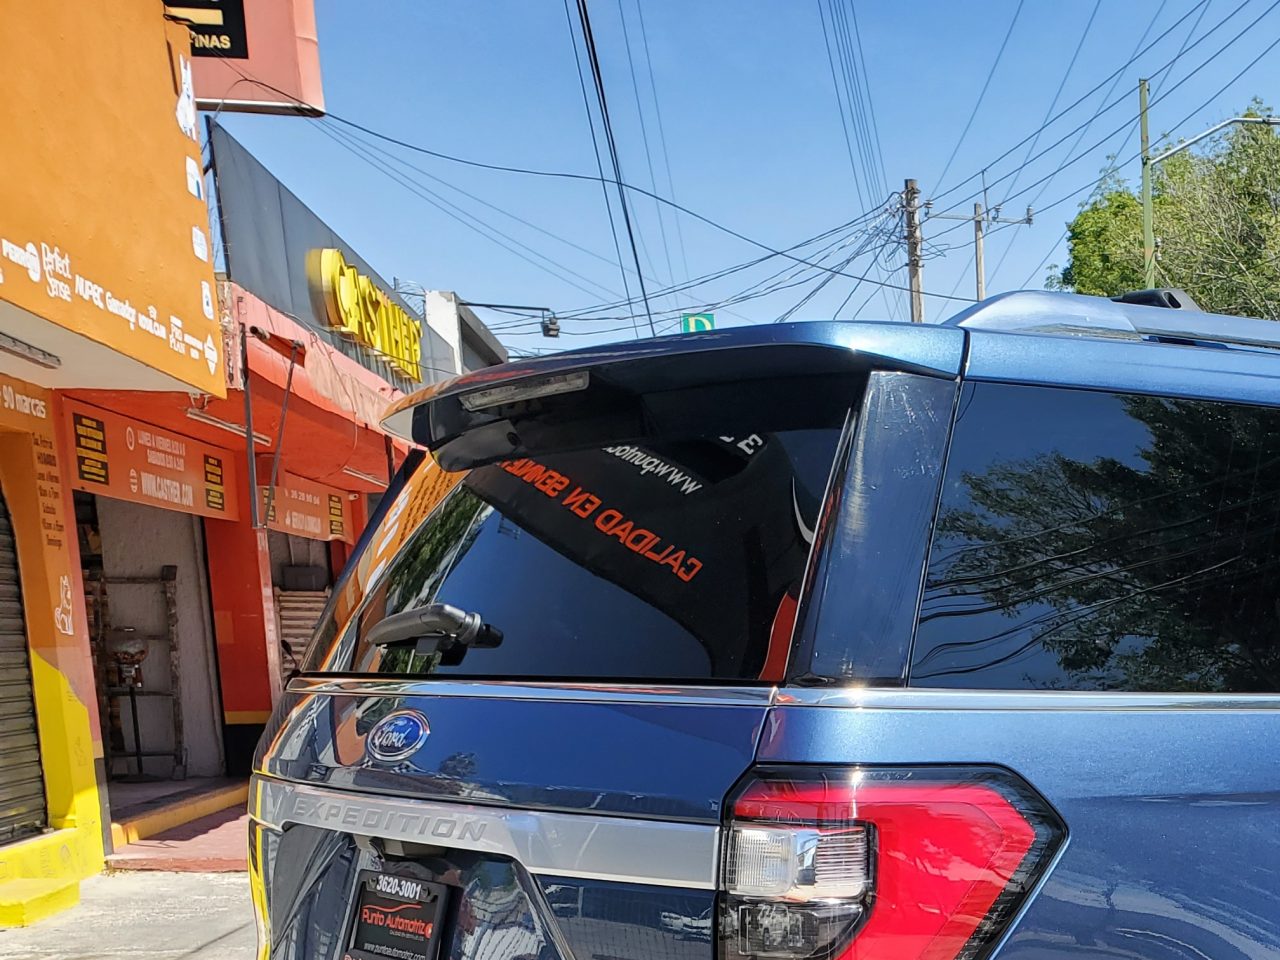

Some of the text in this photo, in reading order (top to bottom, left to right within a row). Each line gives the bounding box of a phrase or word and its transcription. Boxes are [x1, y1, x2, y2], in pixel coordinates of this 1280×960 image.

[321, 248, 422, 383] CASTHER
[3, 385, 46, 419] 90 marcas
[374, 720, 412, 750] Ford
[292, 797, 488, 842] EXPEDITION
[376, 874, 422, 900] 3620-3001
[362, 909, 425, 936] Punto Automotriz
